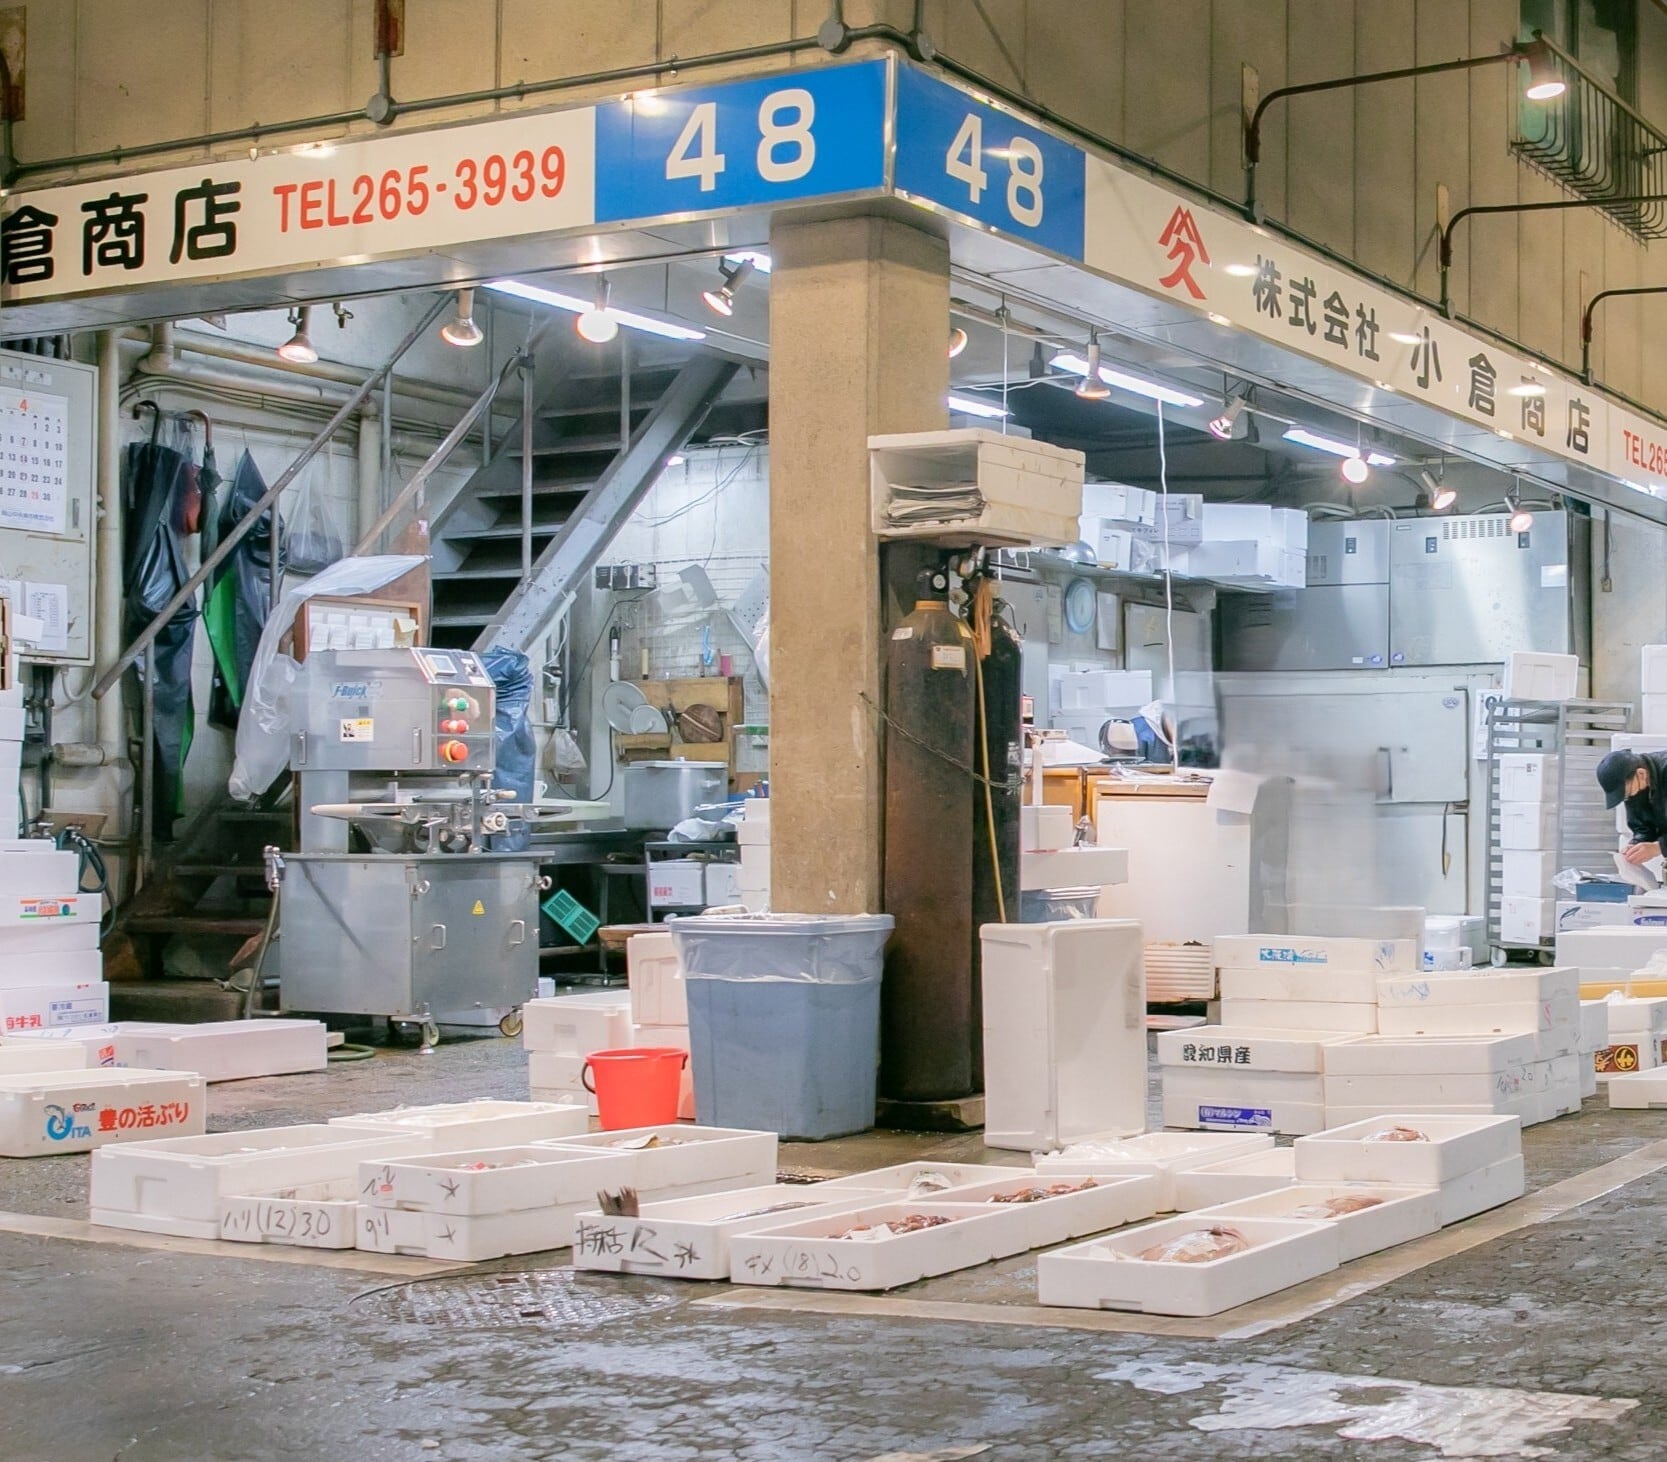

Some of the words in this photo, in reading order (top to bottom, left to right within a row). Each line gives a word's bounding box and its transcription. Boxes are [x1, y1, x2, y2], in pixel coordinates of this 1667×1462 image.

[666, 88, 816, 192] 48
[945, 112, 1044, 229] 48
[1, 177, 243, 285] 倉商店
[273, 145, 566, 233] TEL265-3939
[19, 398, 28, 412] 4
[1252, 253, 1381, 363] 株式会社
[1410, 325, 1591, 455] 小倉商店
[97, 1102, 189, 1132] 豊の活ぶり
